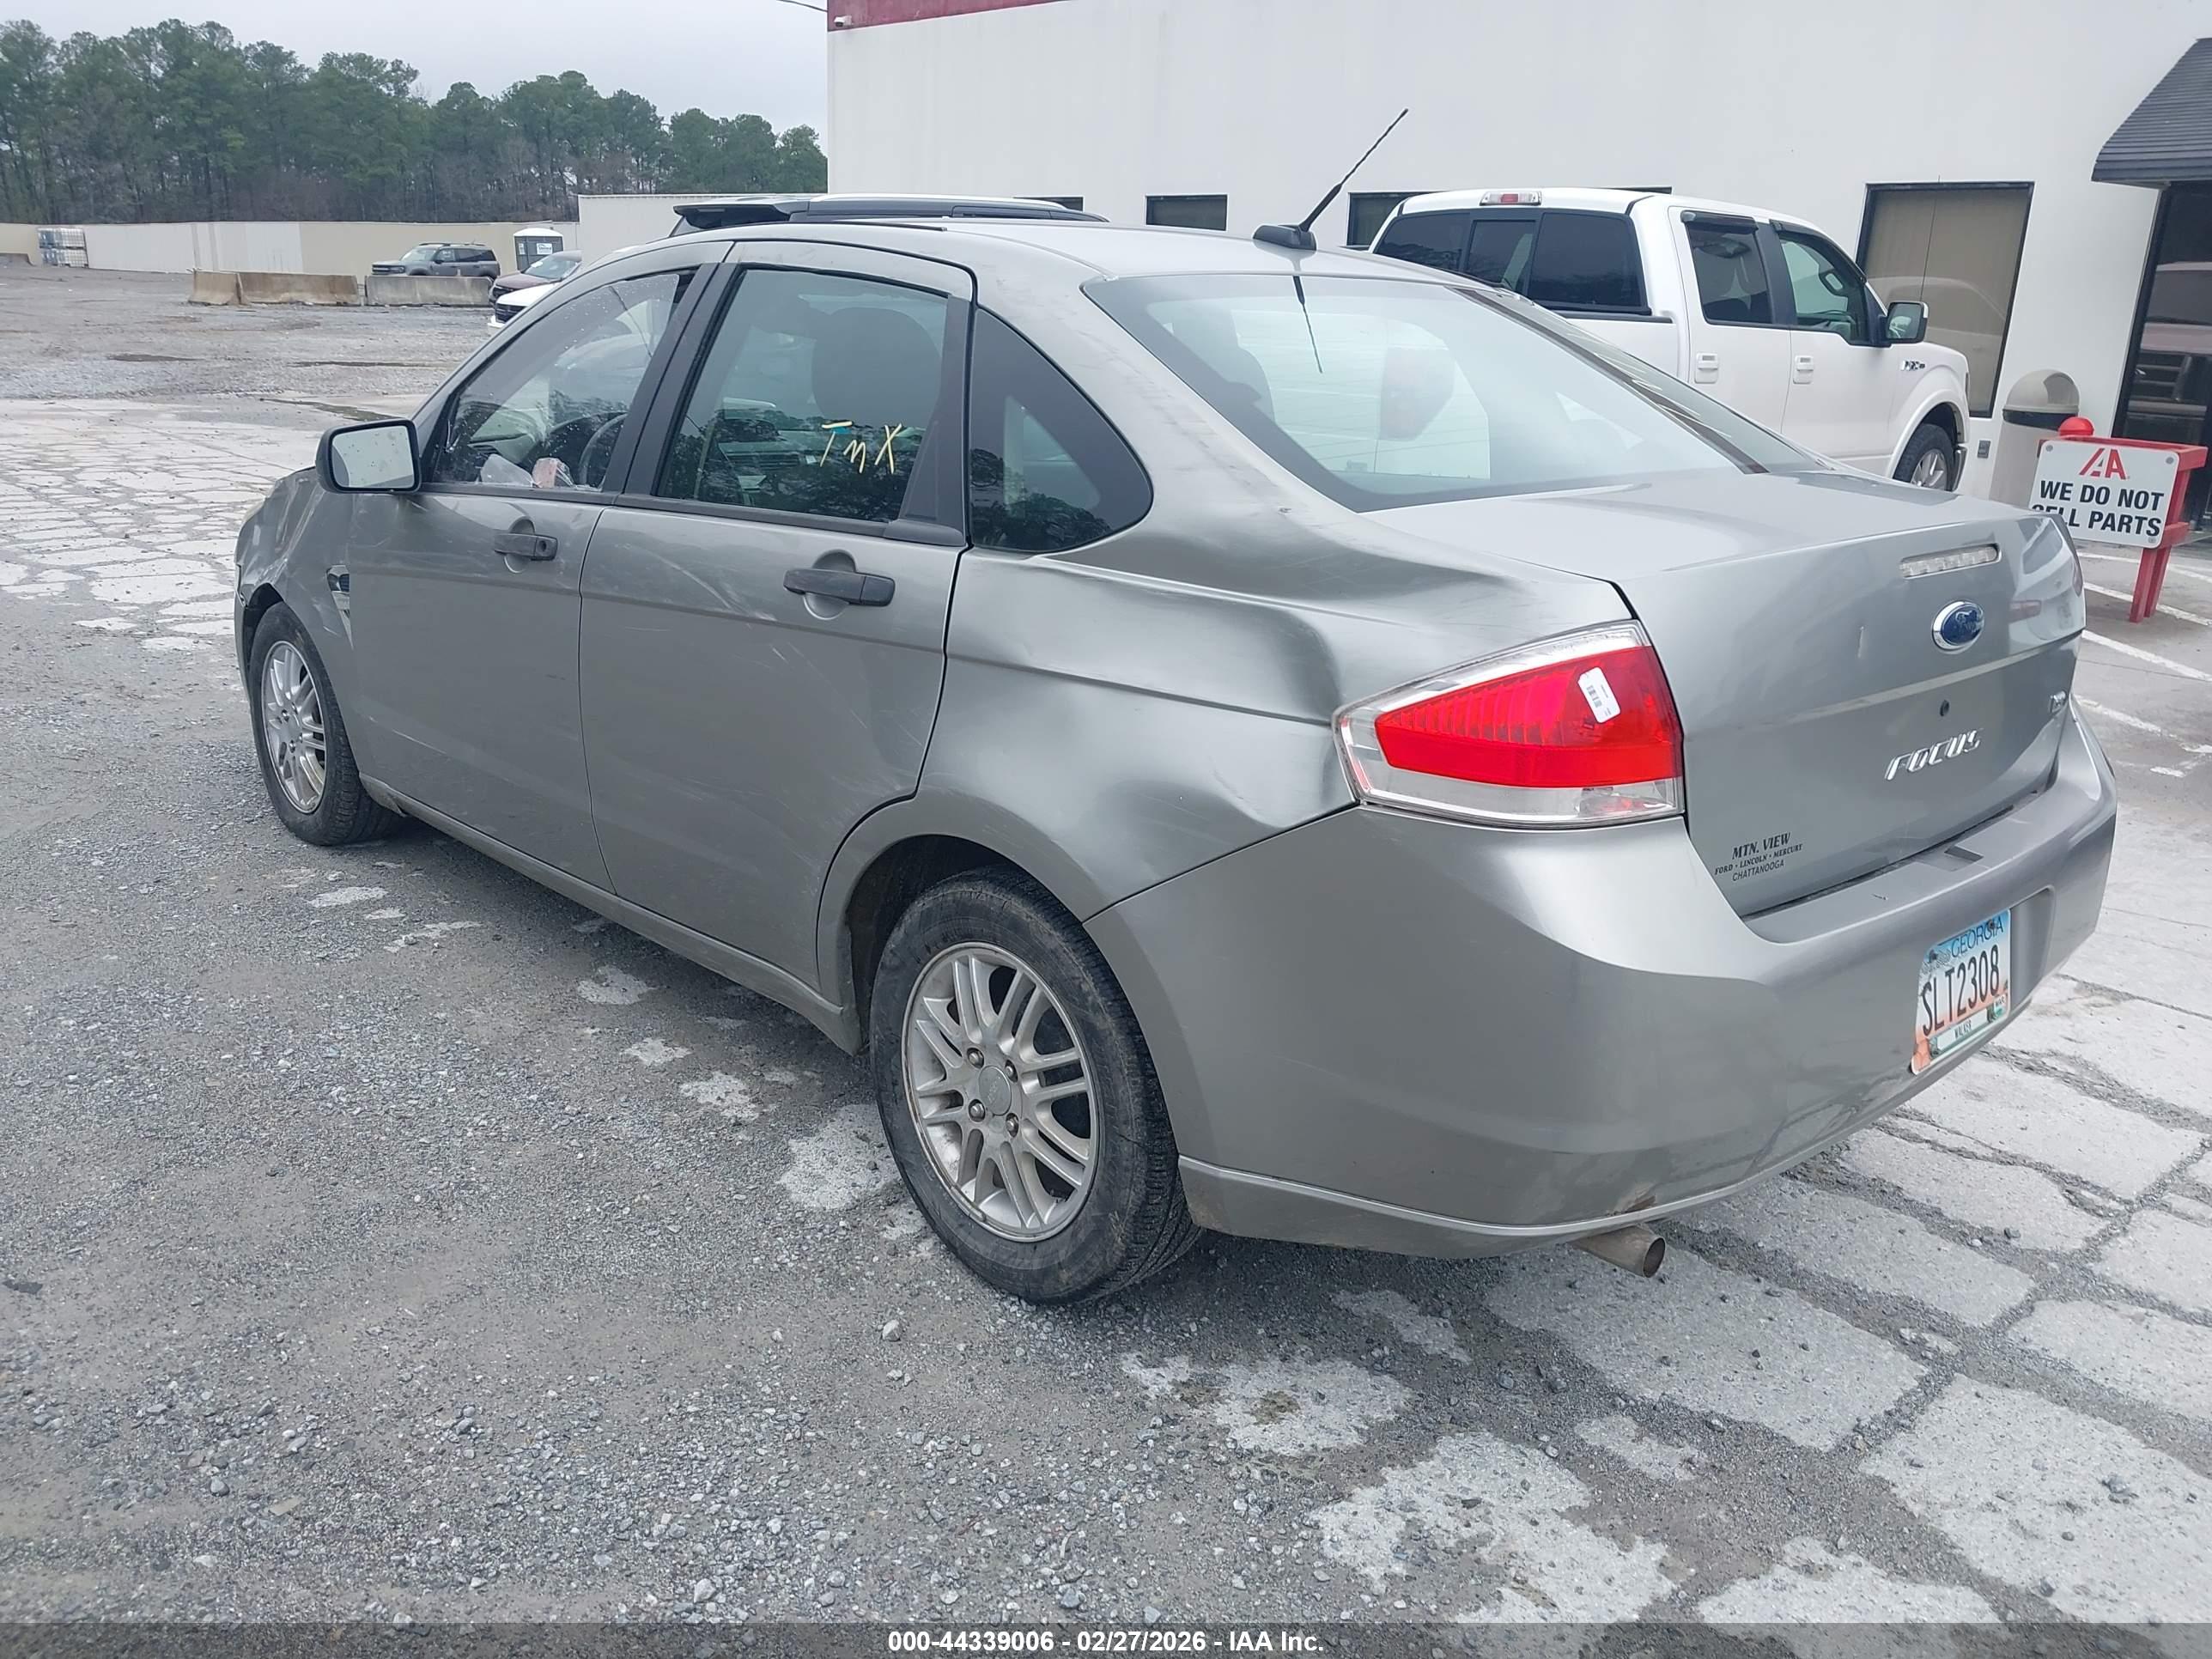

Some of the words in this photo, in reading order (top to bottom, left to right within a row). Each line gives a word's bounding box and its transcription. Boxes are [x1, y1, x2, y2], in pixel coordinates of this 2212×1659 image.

[2040, 480, 2074, 501] WE
[2079, 484, 2111, 505] DO
[2117, 489, 2165, 511] NOT
[2087, 511, 2162, 537] PARTS
[1885, 728, 1981, 781] FOCUS
[1714, 864, 1734, 876] FORD
[1739, 854, 1768, 869] LINCOLN
[1772, 843, 1803, 859] MERCURY
[1732, 842, 1759, 860] MTN.
[1763, 832, 1791, 851] VIEW
[1732, 859, 1785, 882] CHATTANOOGA
[1951, 915, 2004, 958] GEORGIA
[1921, 945, 2000, 1036] SLT2308
